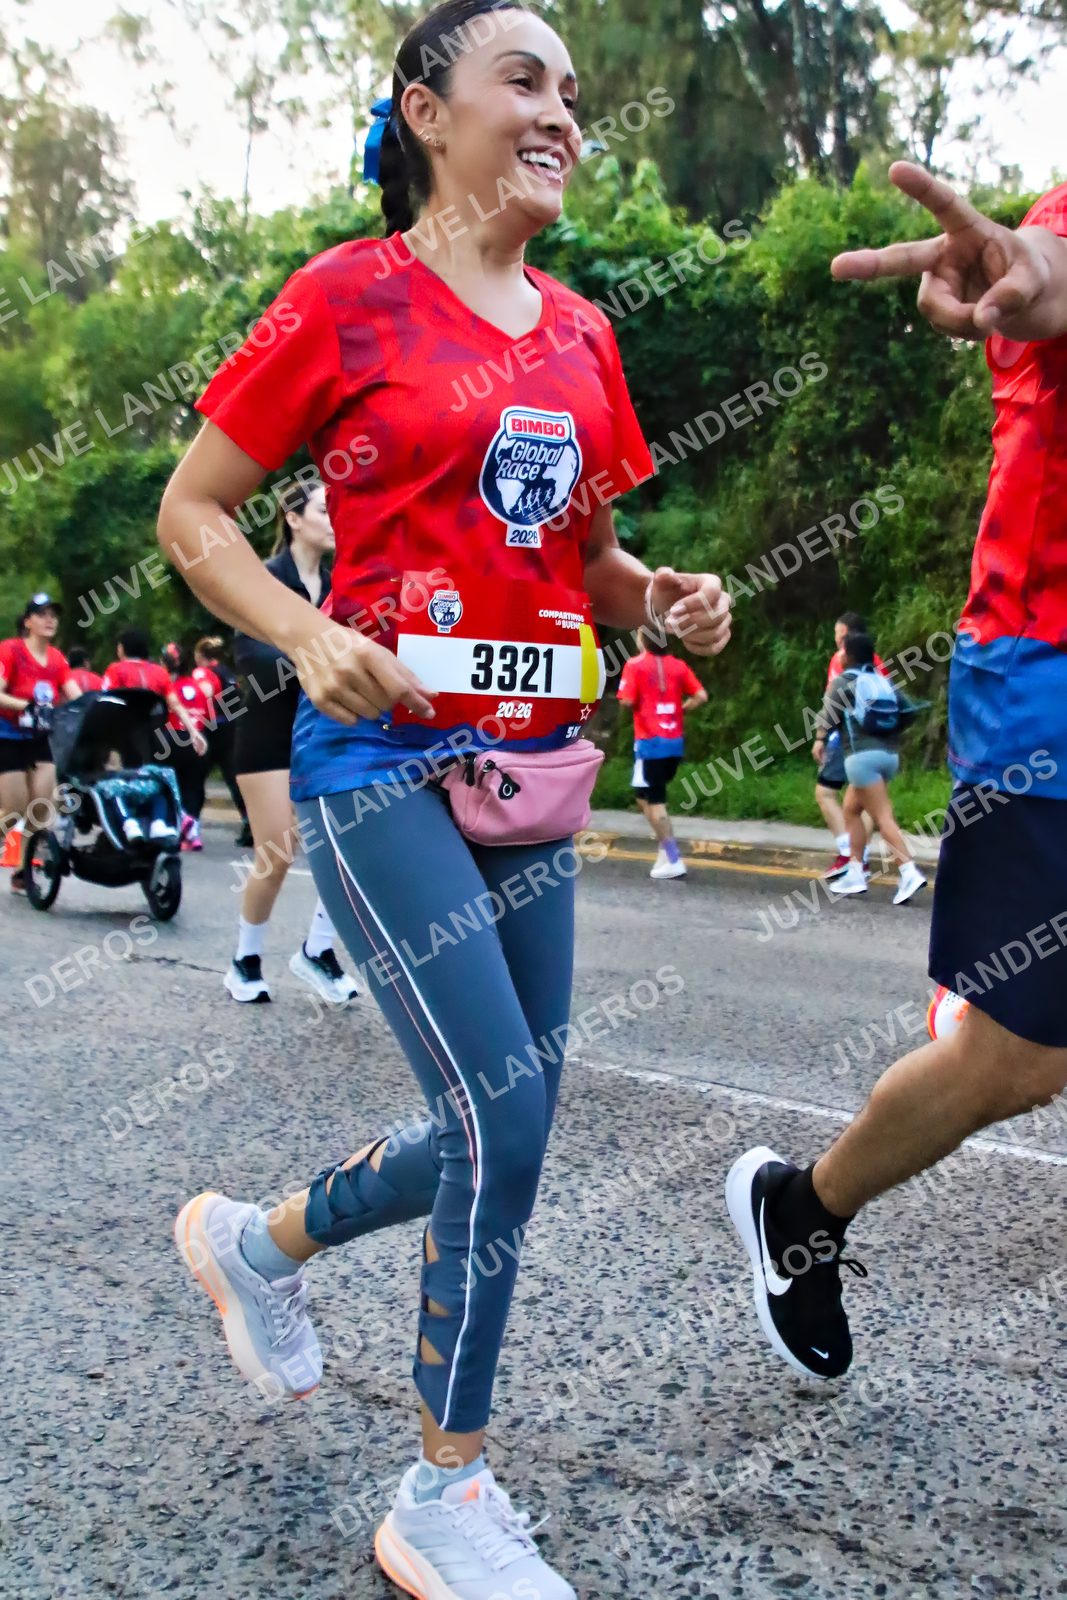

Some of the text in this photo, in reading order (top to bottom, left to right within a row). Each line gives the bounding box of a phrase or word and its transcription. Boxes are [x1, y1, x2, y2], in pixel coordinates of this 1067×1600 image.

[511, 418, 565, 437] BIMBO
[511, 441, 563, 465] Global
[496, 459, 540, 480] Race
[509, 529, 538, 544] 2026
[562, 620, 580, 630] BUEN
[471, 643, 554, 693] 3321
